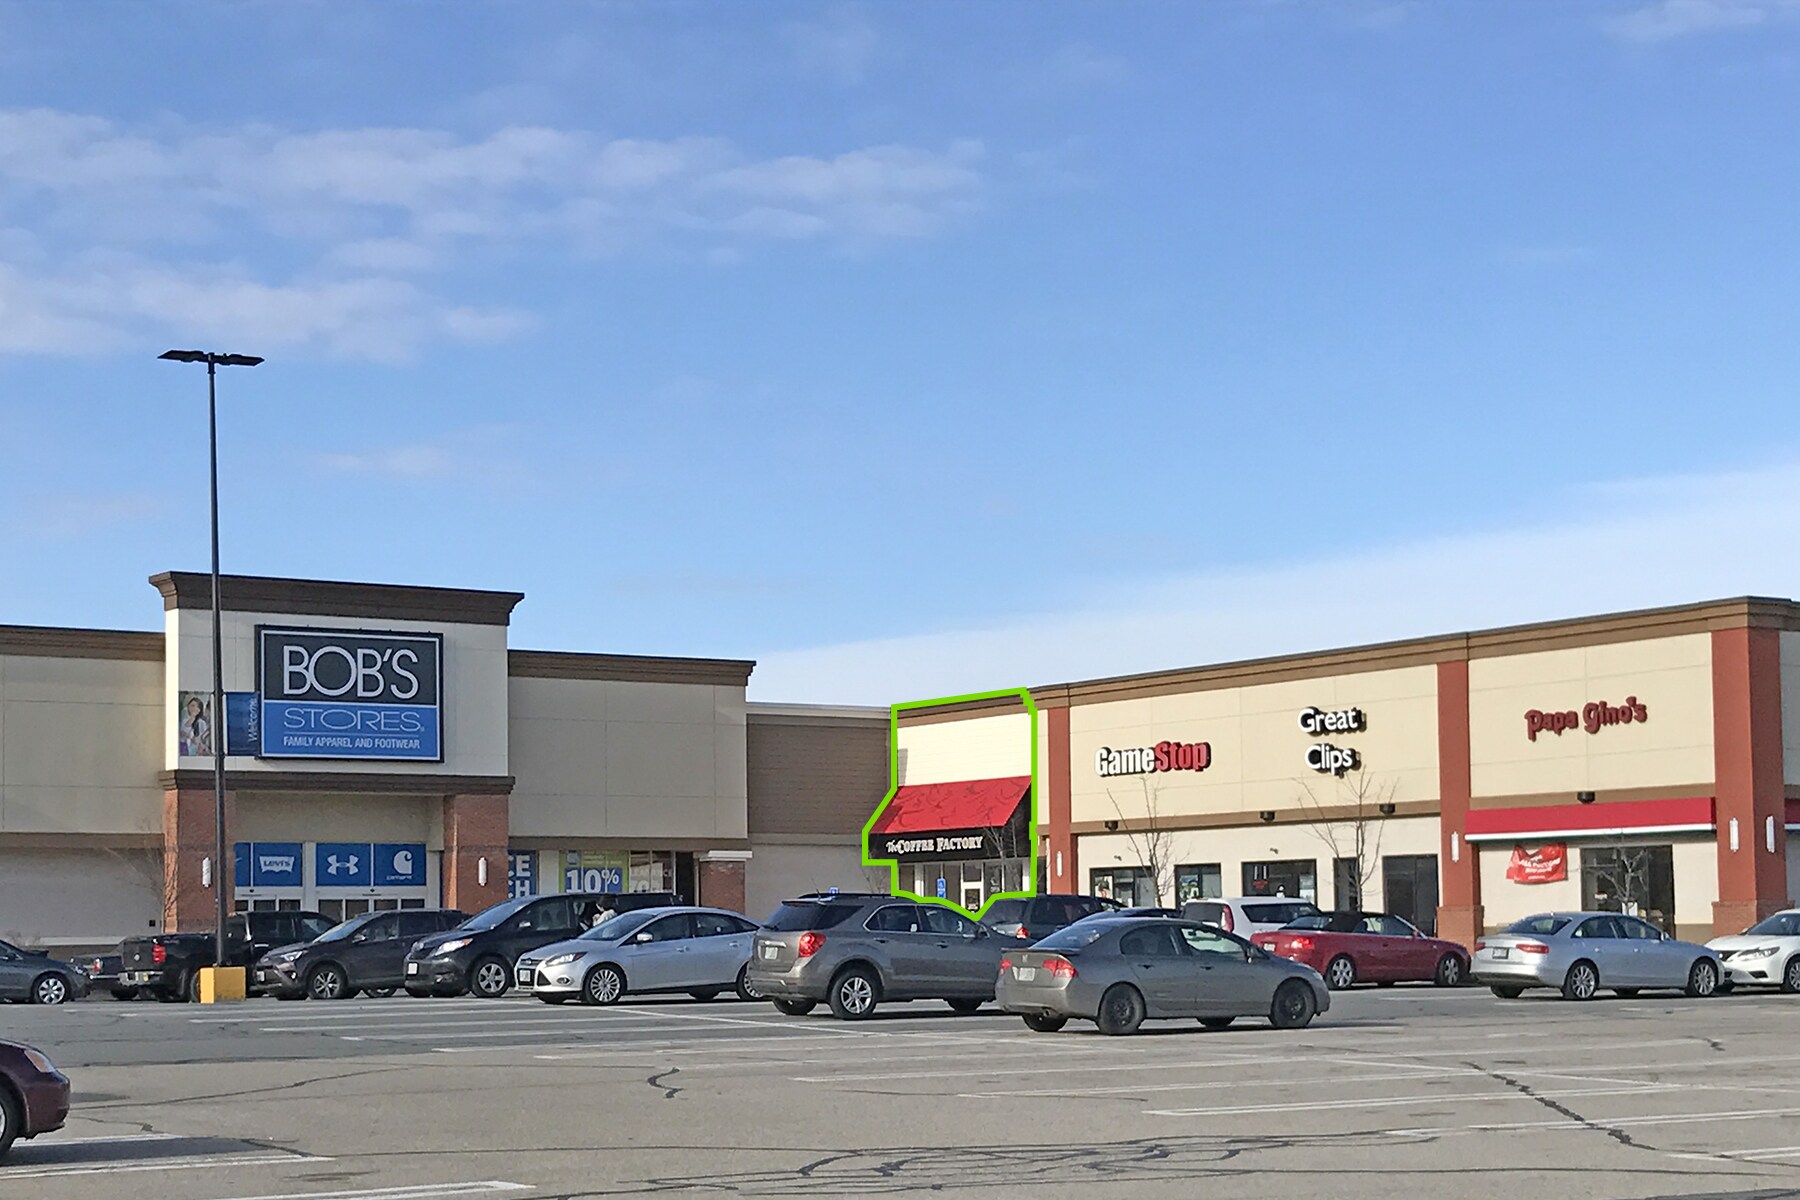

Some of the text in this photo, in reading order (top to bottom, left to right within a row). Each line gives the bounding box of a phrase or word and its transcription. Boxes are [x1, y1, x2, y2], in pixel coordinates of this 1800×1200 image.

[283, 645, 419, 699] BOB'S
[283, 707, 422, 732] STORES
[1297, 707, 1360, 733] Great
[1524, 695, 1648, 741] Papa Gino's
[283, 736, 421, 750] FAMILY APPAREL AND FOOTWEAR
[1095, 741, 1211, 776] GameStop
[1304, 743, 1355, 776] Clips
[885, 836, 983, 854] The COFFEE FACTORY
[566, 868, 620, 893] 10%
